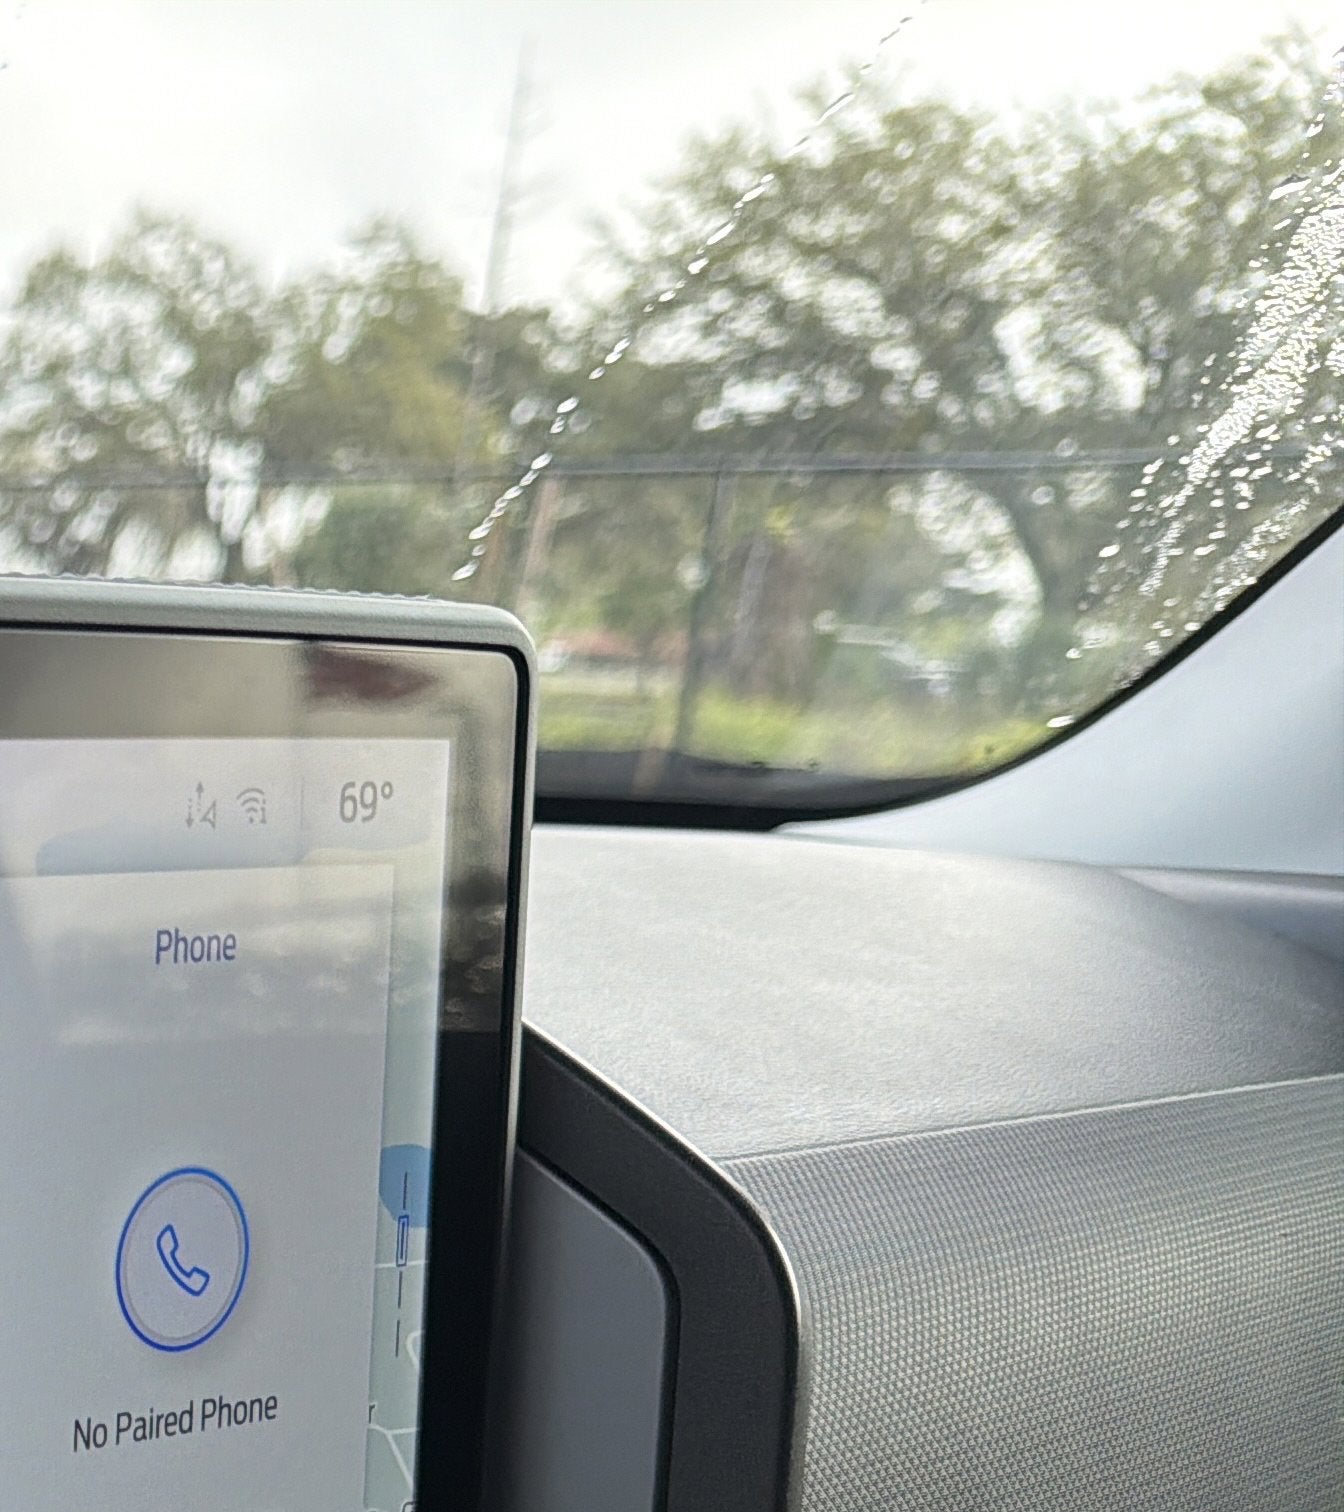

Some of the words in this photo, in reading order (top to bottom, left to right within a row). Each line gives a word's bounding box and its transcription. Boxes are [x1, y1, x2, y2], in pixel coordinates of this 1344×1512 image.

[155, 927, 237, 965] Phone
[73, 1418, 108, 1453] No
[115, 1401, 194, 1446] Paired
[200, 1395, 278, 1432] Phone
